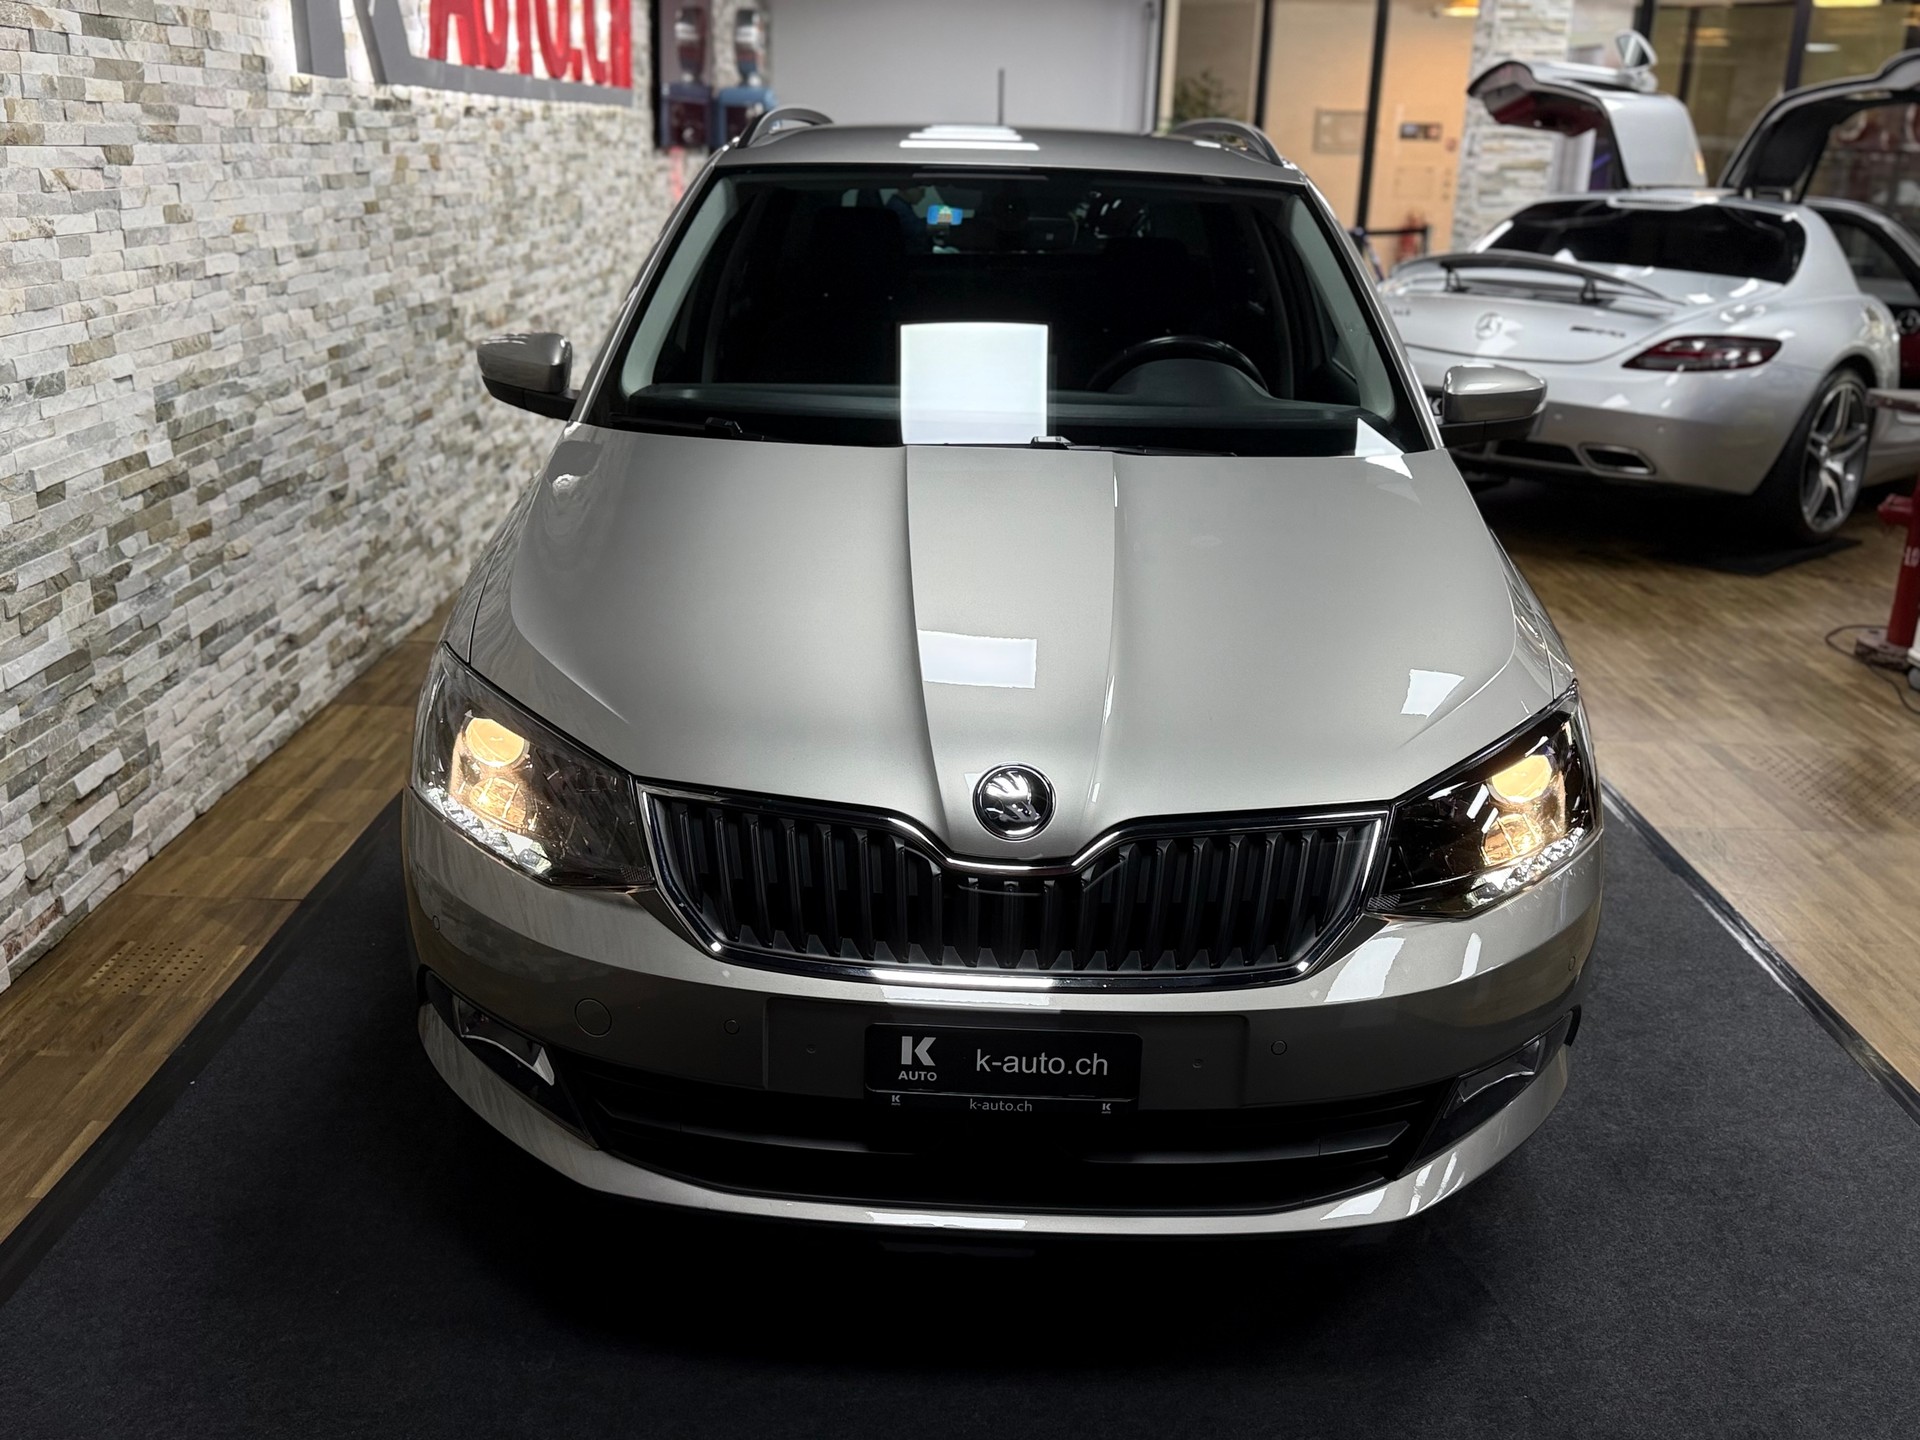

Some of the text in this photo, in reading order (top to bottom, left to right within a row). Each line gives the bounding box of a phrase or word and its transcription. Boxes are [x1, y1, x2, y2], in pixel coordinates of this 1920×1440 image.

[901, 1036, 937, 1067] K
[976, 1049, 1108, 1076] k-auto.ch
[898, 1070, 937, 1082] AUTO
[969, 1098, 1033, 1112] k-auto.ch
